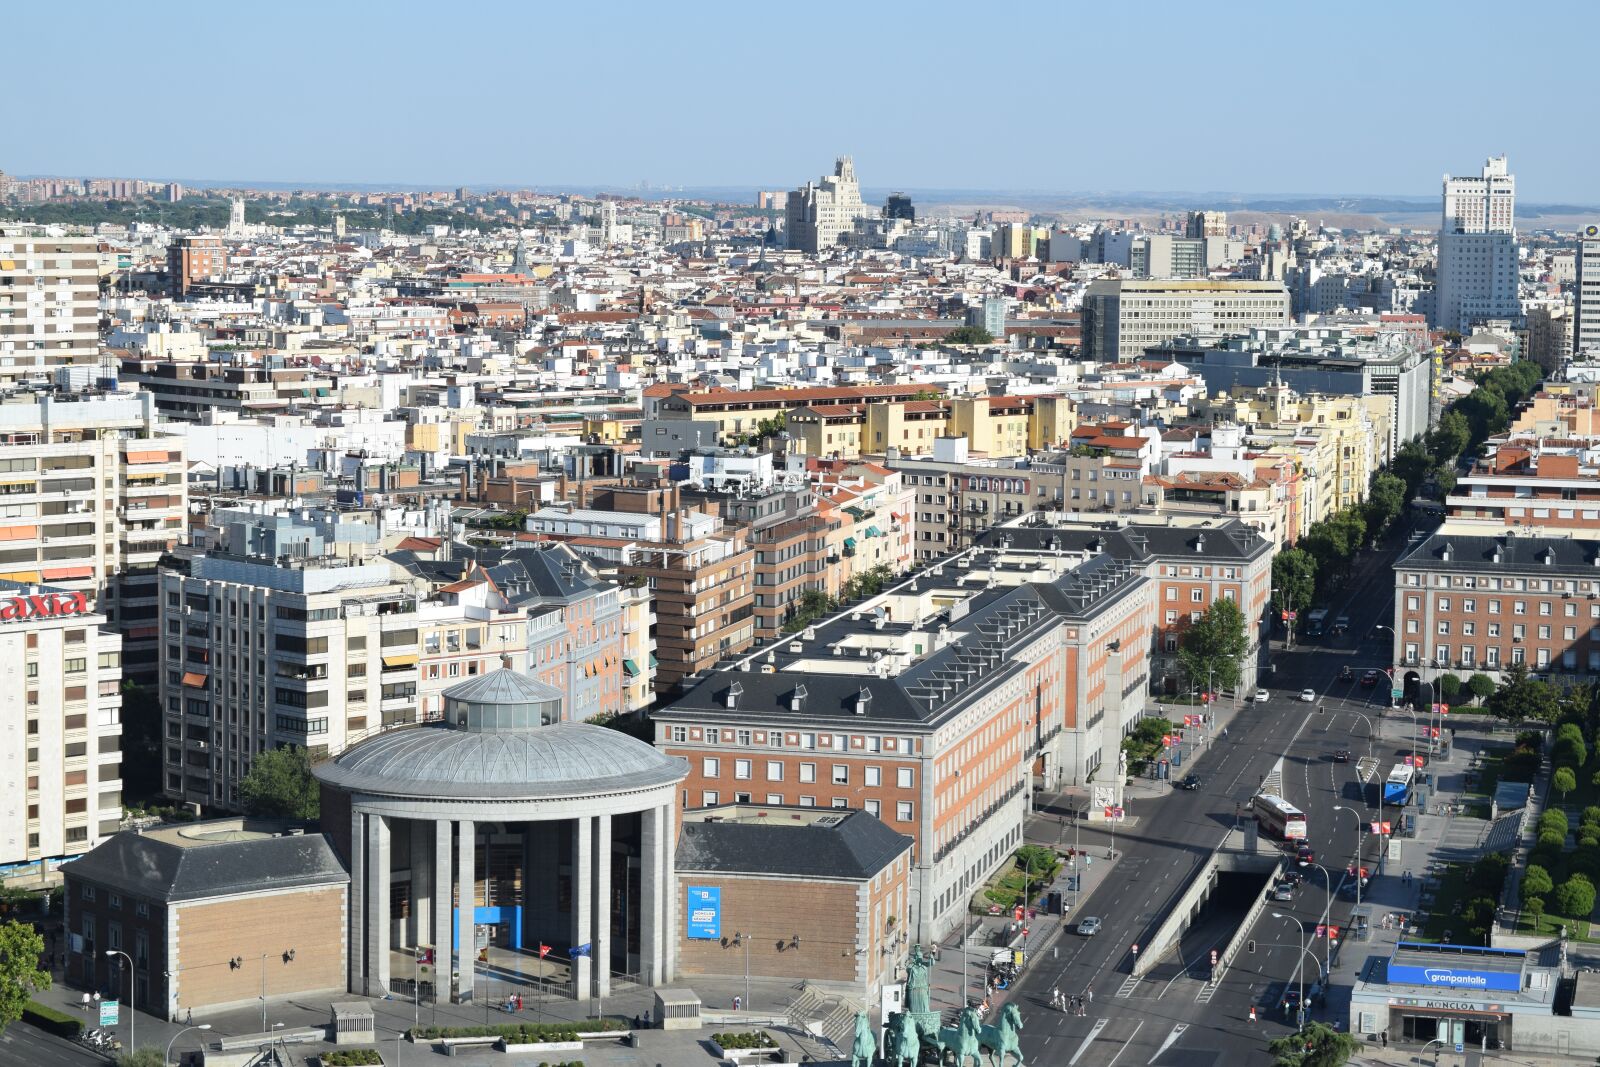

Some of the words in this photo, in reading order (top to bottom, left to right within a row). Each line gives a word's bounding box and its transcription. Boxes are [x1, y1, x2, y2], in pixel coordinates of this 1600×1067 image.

[1433, 345, 1443, 397] HOTEL
[1431, 975, 1487, 984] granpantalla
[1426, 1001, 1475, 1011] MONCLOA
